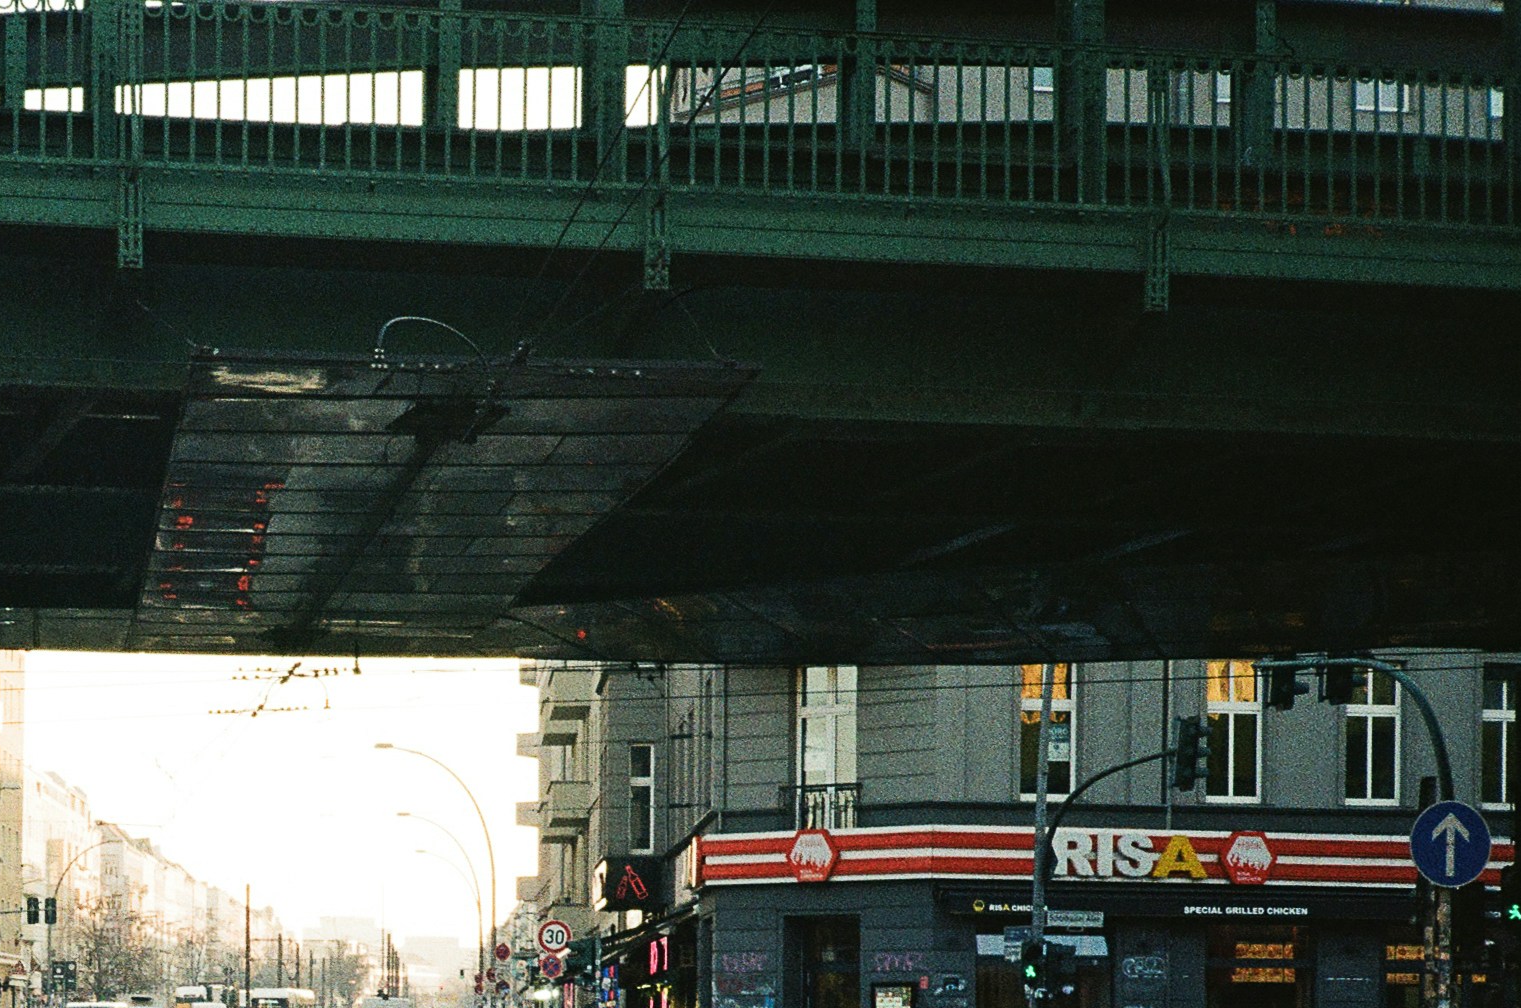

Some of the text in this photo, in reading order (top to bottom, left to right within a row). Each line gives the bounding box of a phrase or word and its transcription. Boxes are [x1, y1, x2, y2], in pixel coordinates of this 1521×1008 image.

[1051, 831, 1208, 878] RISA
[988, 904, 1011, 912] RISA
[1183, 905, 1309, 916] SPECIAL GRILLED CHICKEN
[545, 928, 565, 945] 30
